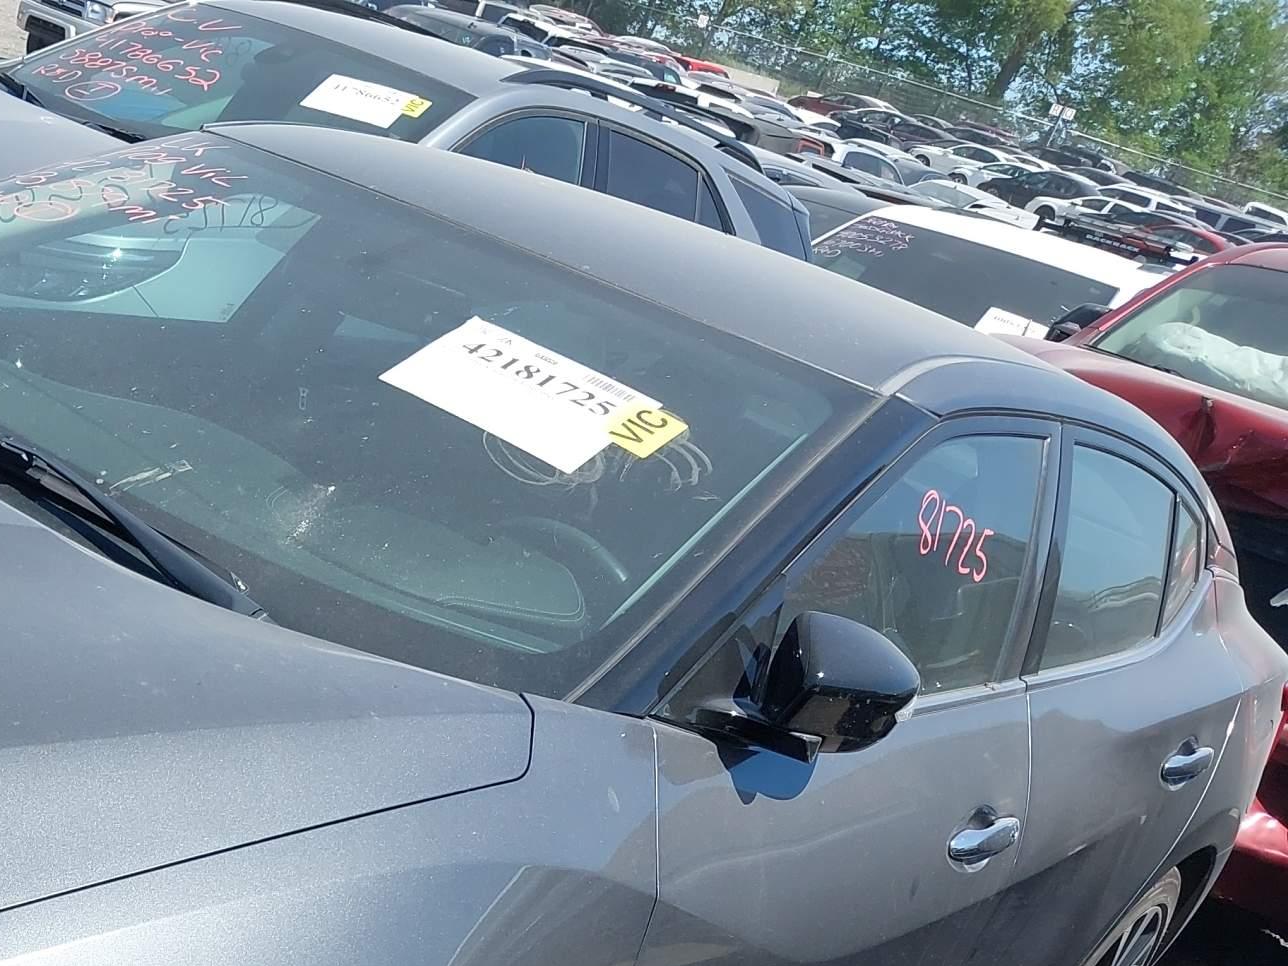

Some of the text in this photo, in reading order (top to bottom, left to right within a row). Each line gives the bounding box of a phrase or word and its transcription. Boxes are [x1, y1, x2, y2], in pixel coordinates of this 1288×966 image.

[462, 341, 617, 417] 42181725
[609, 409, 669, 444] VIC
[918, 489, 995, 583] 81725
